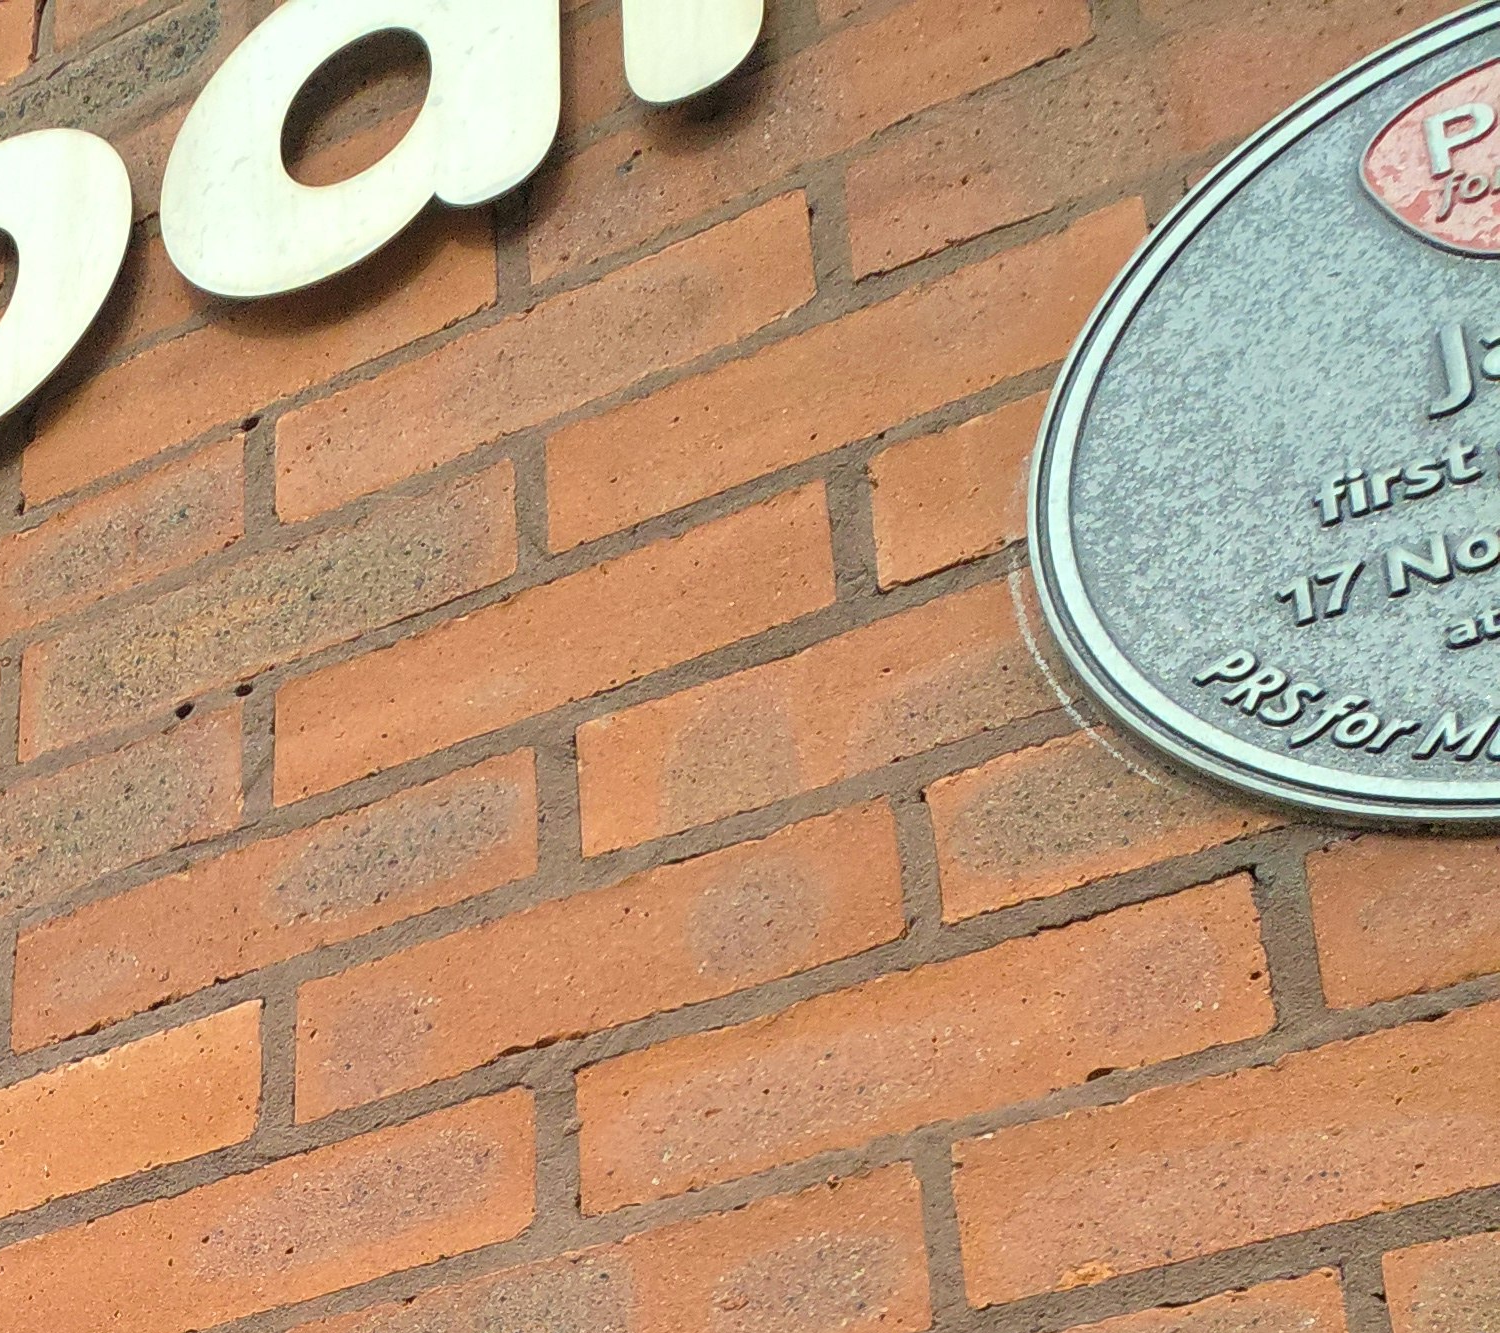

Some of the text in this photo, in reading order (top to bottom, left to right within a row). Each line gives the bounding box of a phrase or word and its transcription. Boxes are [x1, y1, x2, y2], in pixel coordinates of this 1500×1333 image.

[1436, 165, 1500, 222] fo
[1314, 443, 1485, 527] first
[1276, 560, 1366, 627] 17
[1192, 649, 1328, 727] PRS
[1287, 694, 1422, 755] for
